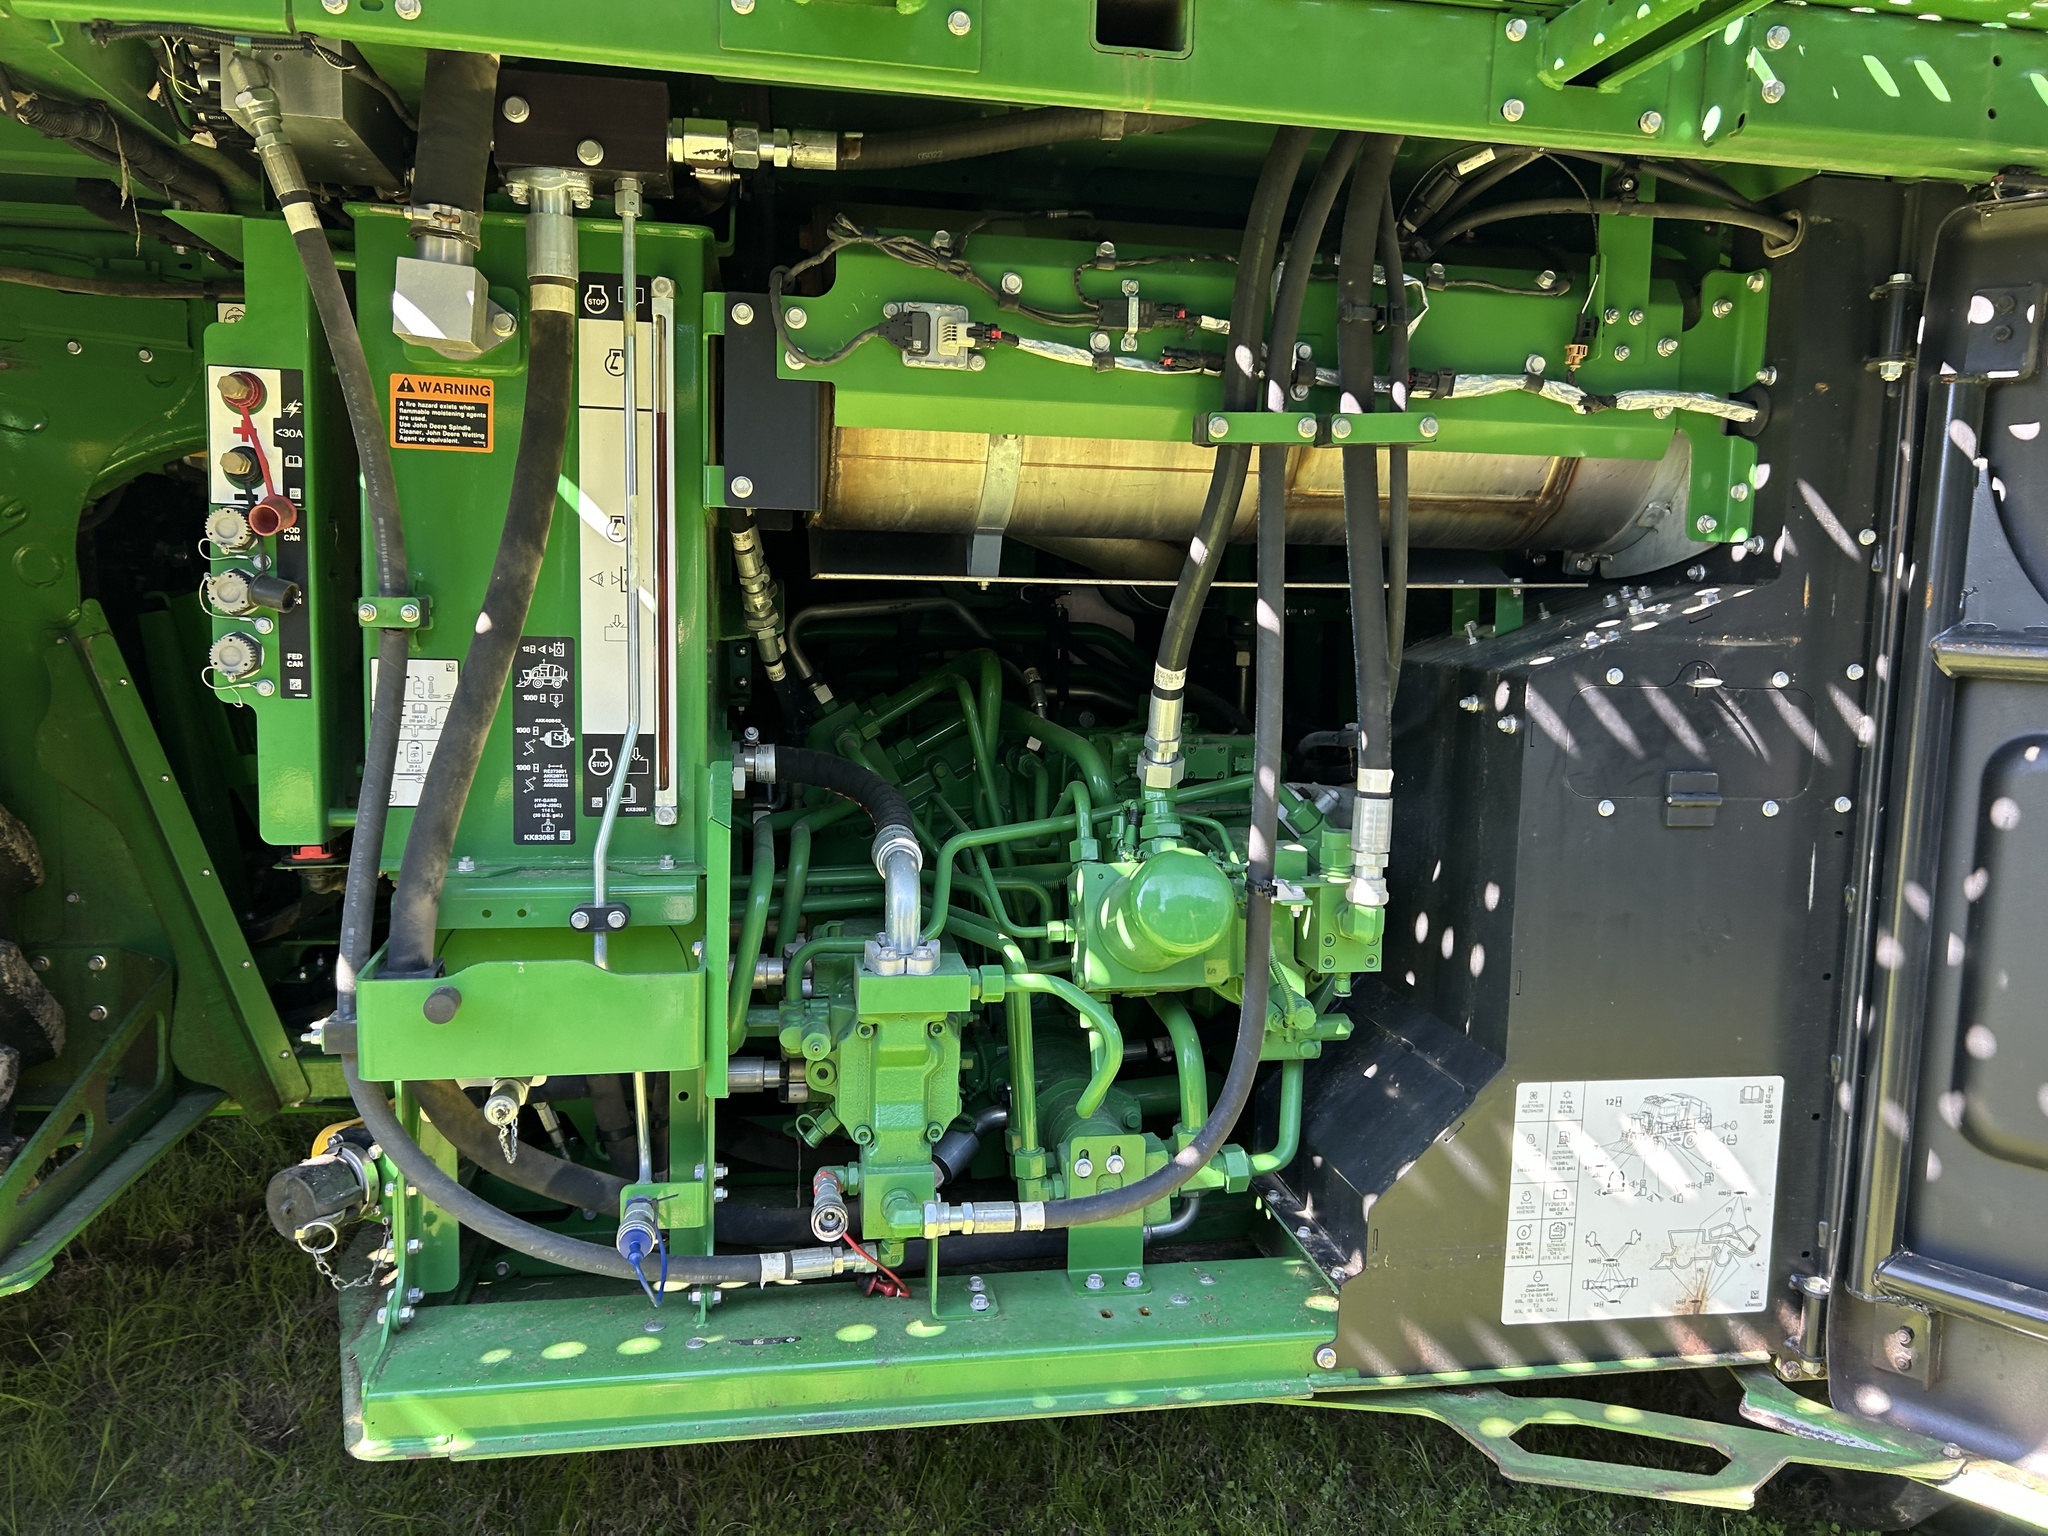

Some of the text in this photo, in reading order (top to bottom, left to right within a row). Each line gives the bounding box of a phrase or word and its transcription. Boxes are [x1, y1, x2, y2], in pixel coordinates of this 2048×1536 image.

[588, 298, 606, 306] STOP
[418, 381, 491, 397] WARNING
[431, 409, 464, 418] moistening
[466, 411, 486, 419] agents
[448, 424, 471, 432] Spindle
[399, 428, 424, 436] Cleaner,
[442, 430, 460, 438] Deere
[462, 431, 485, 440] Wetting
[399, 435, 417, 443] Agent
[287, 660, 303, 668] CAN
[1605, 1098, 1614, 1106] 12
